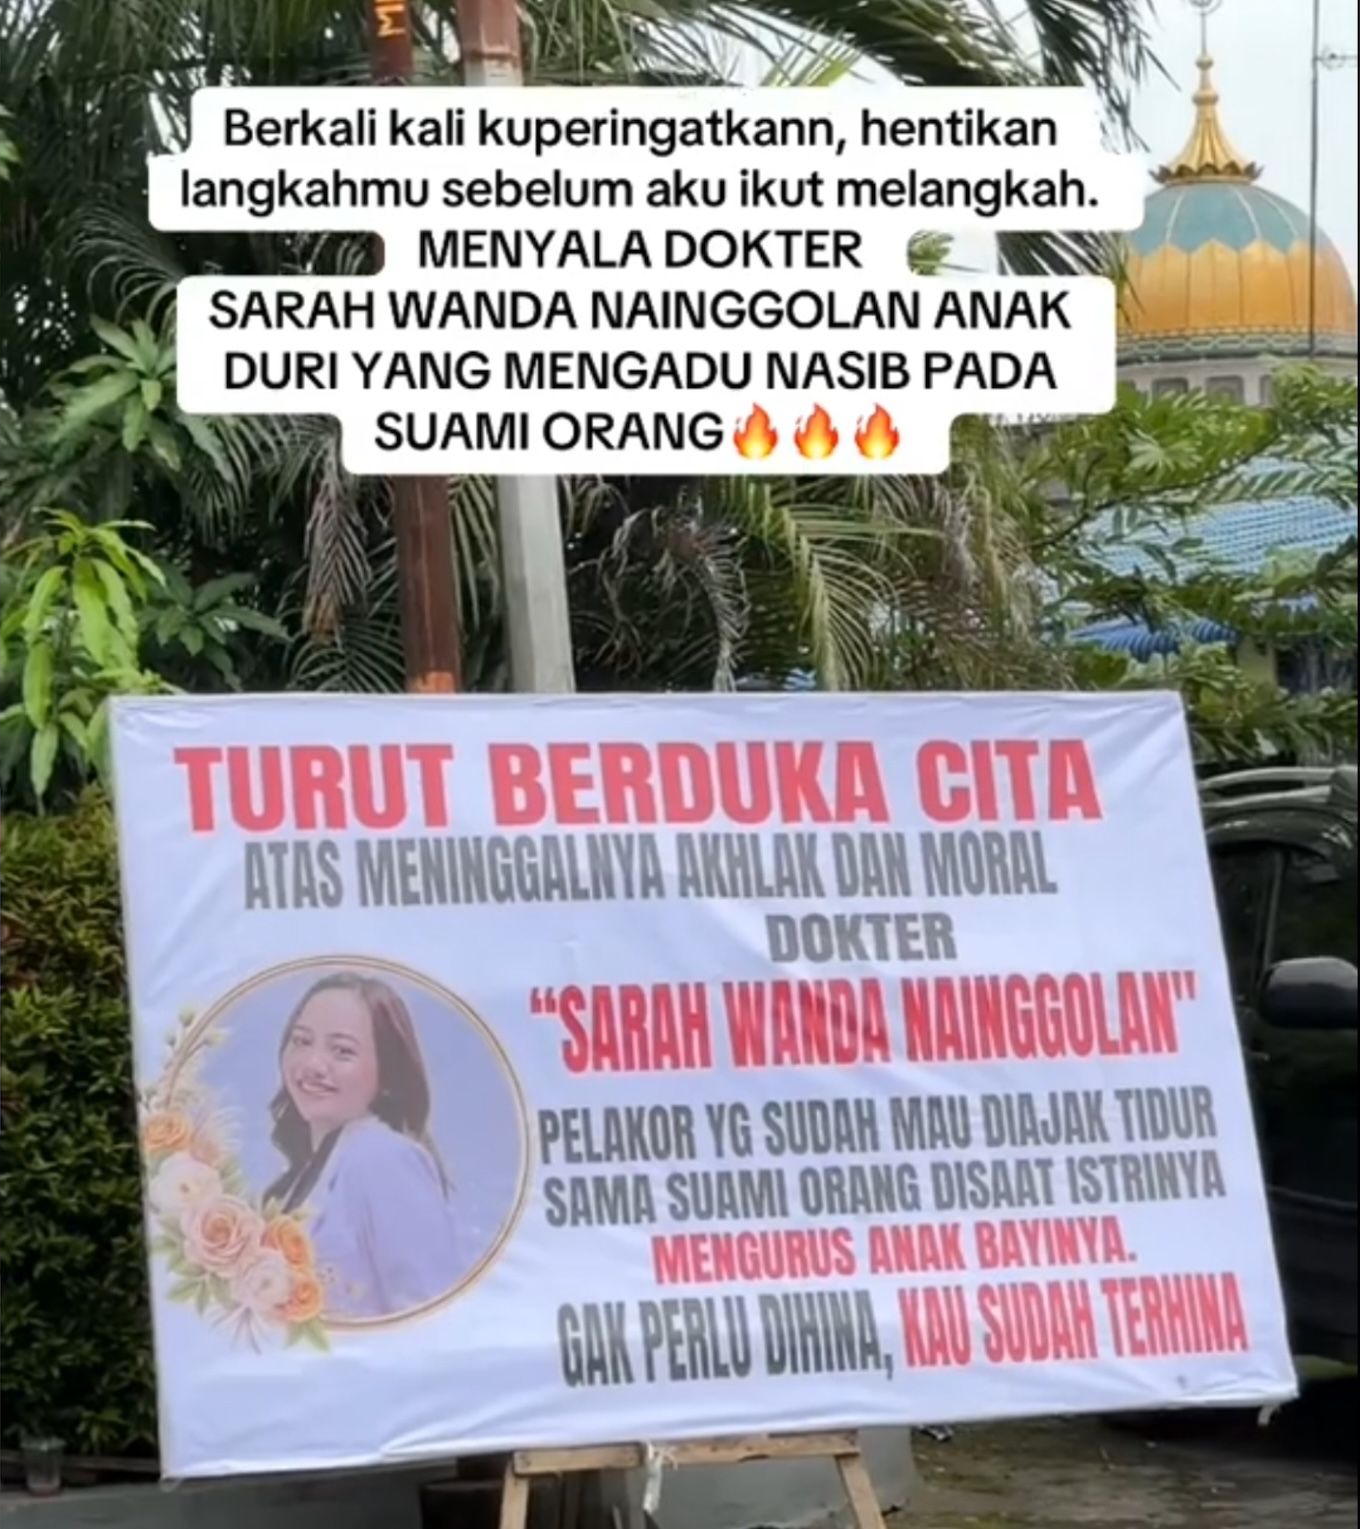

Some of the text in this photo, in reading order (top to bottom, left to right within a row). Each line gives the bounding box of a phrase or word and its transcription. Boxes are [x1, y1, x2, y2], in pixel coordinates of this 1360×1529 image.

[173, 739, 1102, 832] TURUT BERDUKA CITA
[244, 830, 1057, 909] ATAS MENINGGALNYA AKHLAK DAN MORAL
[766, 912, 957, 963] DOKTER
[530, 970, 1195, 1073] “SARAH WANDA NAINGGOLAN"
[538, 1085, 1217, 1164] PELAKOR YG SUDAH MAU DIAJAK TIDUR
[544, 1150, 1226, 1227] SAMA SUAMI ORANG DISAAT ISTRINYA
[651, 1216, 1137, 1285] MENGURUS ANAK BAYINYA.
[557, 1271, 1249, 1387] GAK PERLU DIHINA, KAU SUDAH TERHINA
